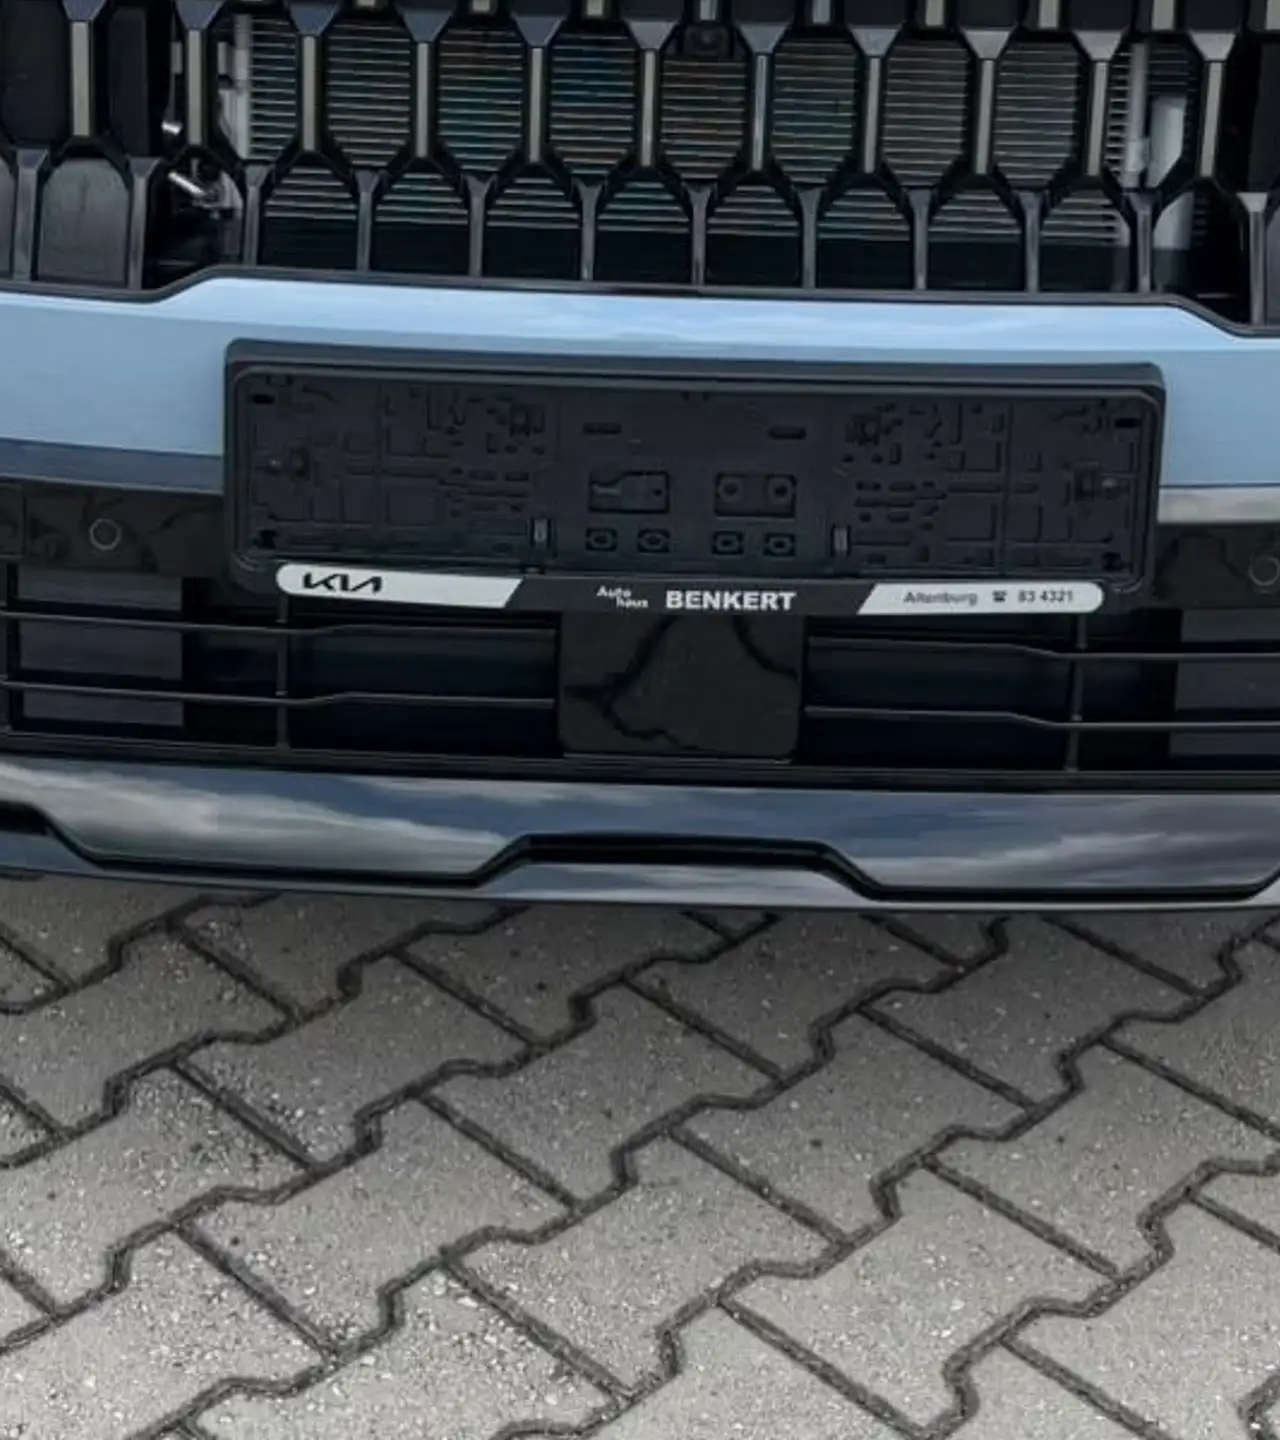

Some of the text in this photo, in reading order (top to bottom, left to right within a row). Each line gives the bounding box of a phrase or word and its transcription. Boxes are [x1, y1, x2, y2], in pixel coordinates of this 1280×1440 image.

[302, 572, 383, 594] KIA
[597, 585, 632, 598] Auto
[665, 590, 797, 610] BENKERT
